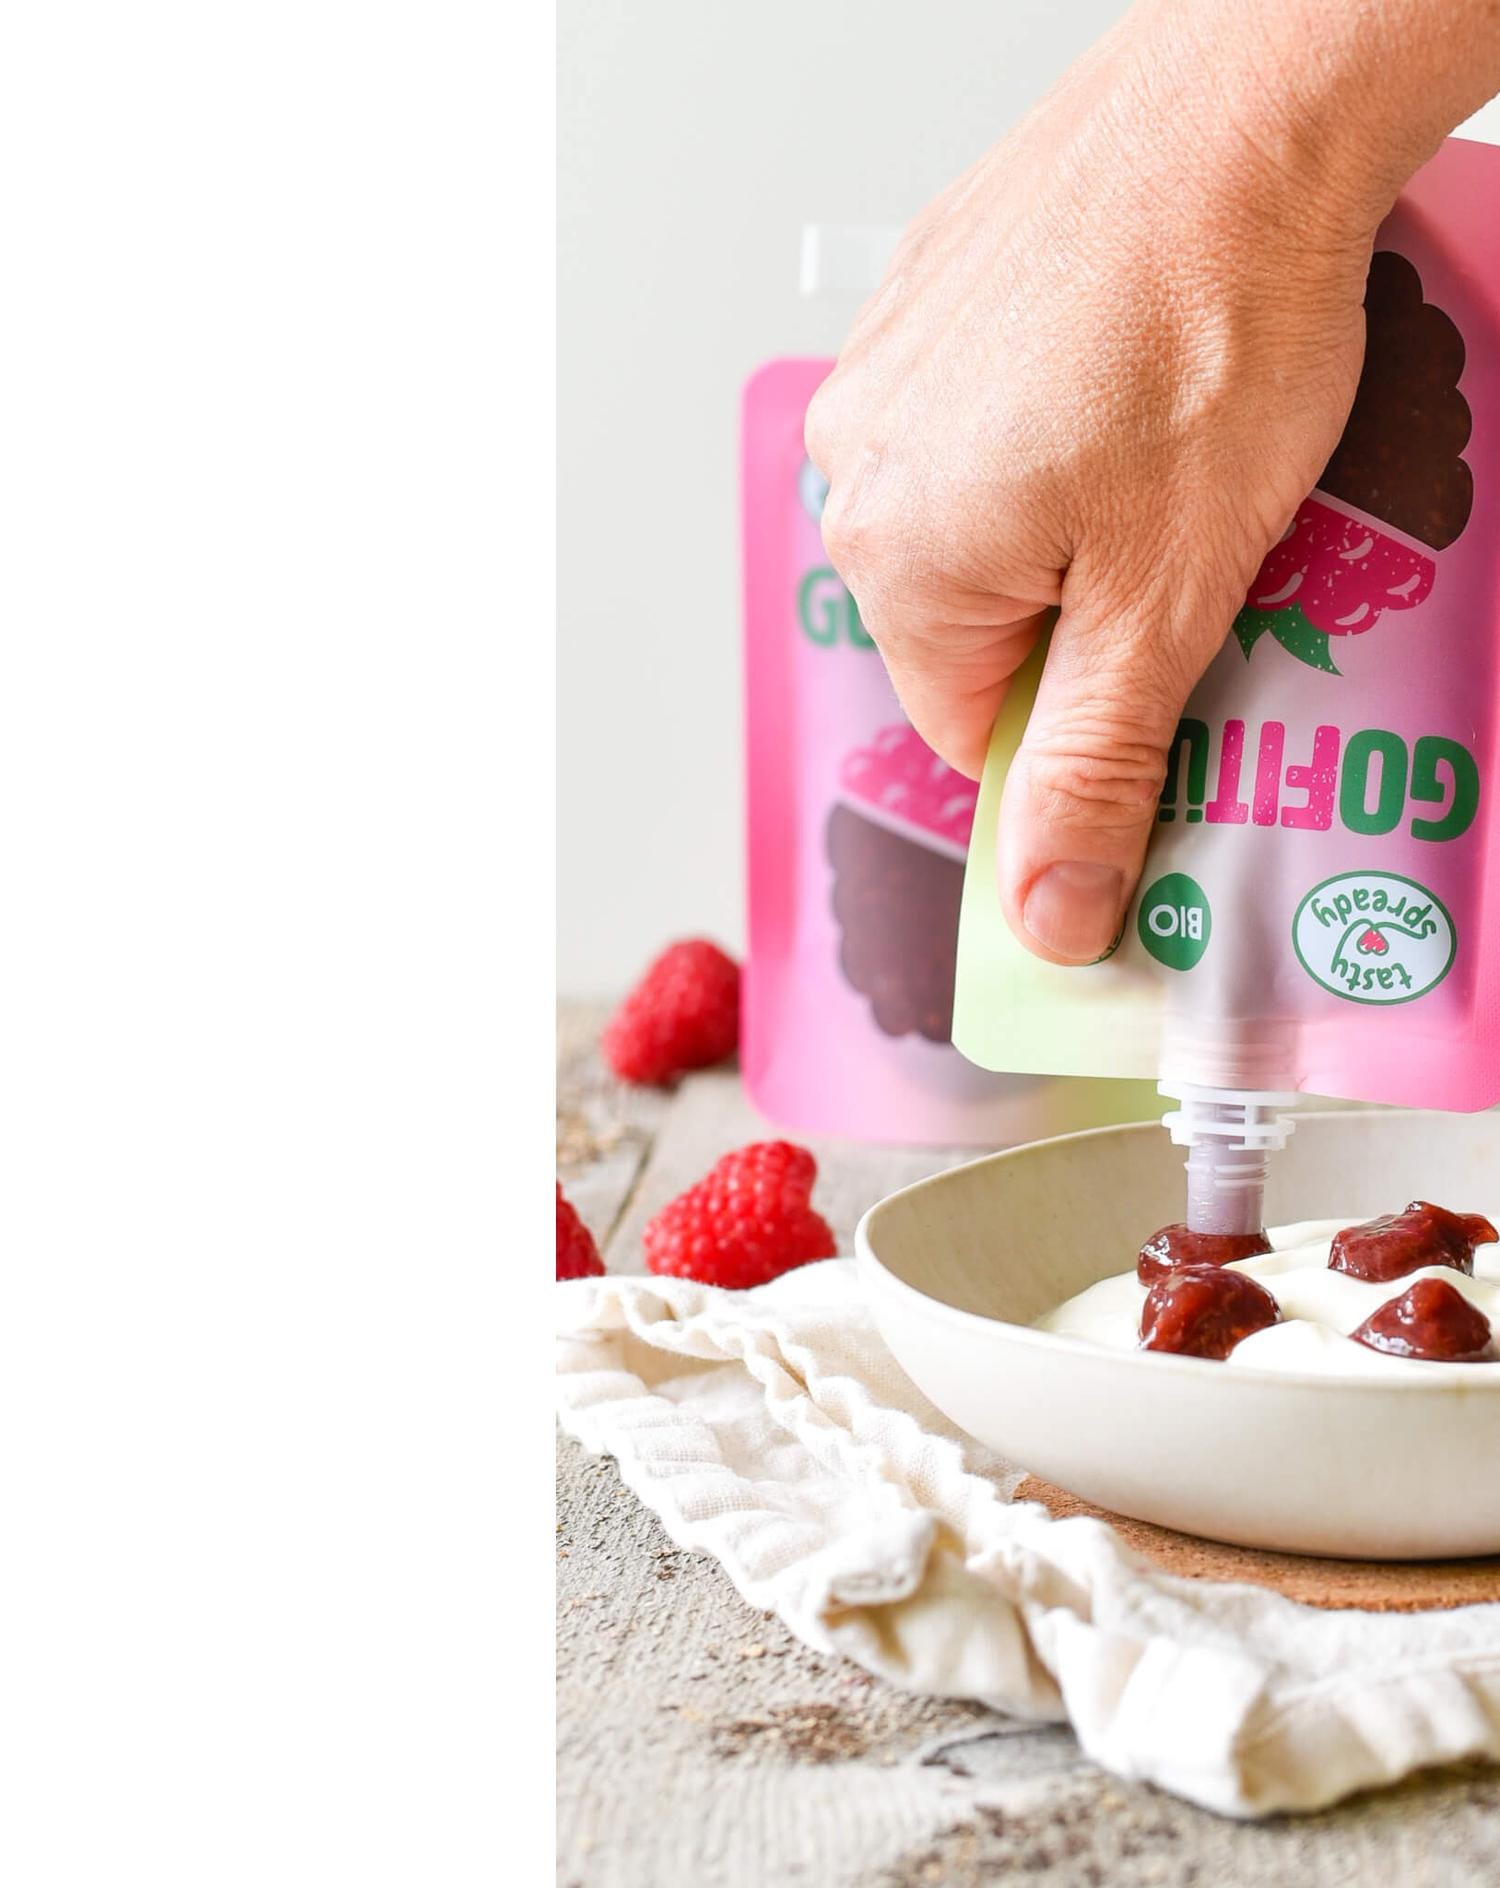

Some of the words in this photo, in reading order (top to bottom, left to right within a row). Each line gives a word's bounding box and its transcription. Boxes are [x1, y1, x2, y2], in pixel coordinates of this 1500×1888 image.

[1148, 904, 1203, 940] BIO
[1311, 888, 1437, 939] spready
[1331, 945, 1412, 991] tasty
